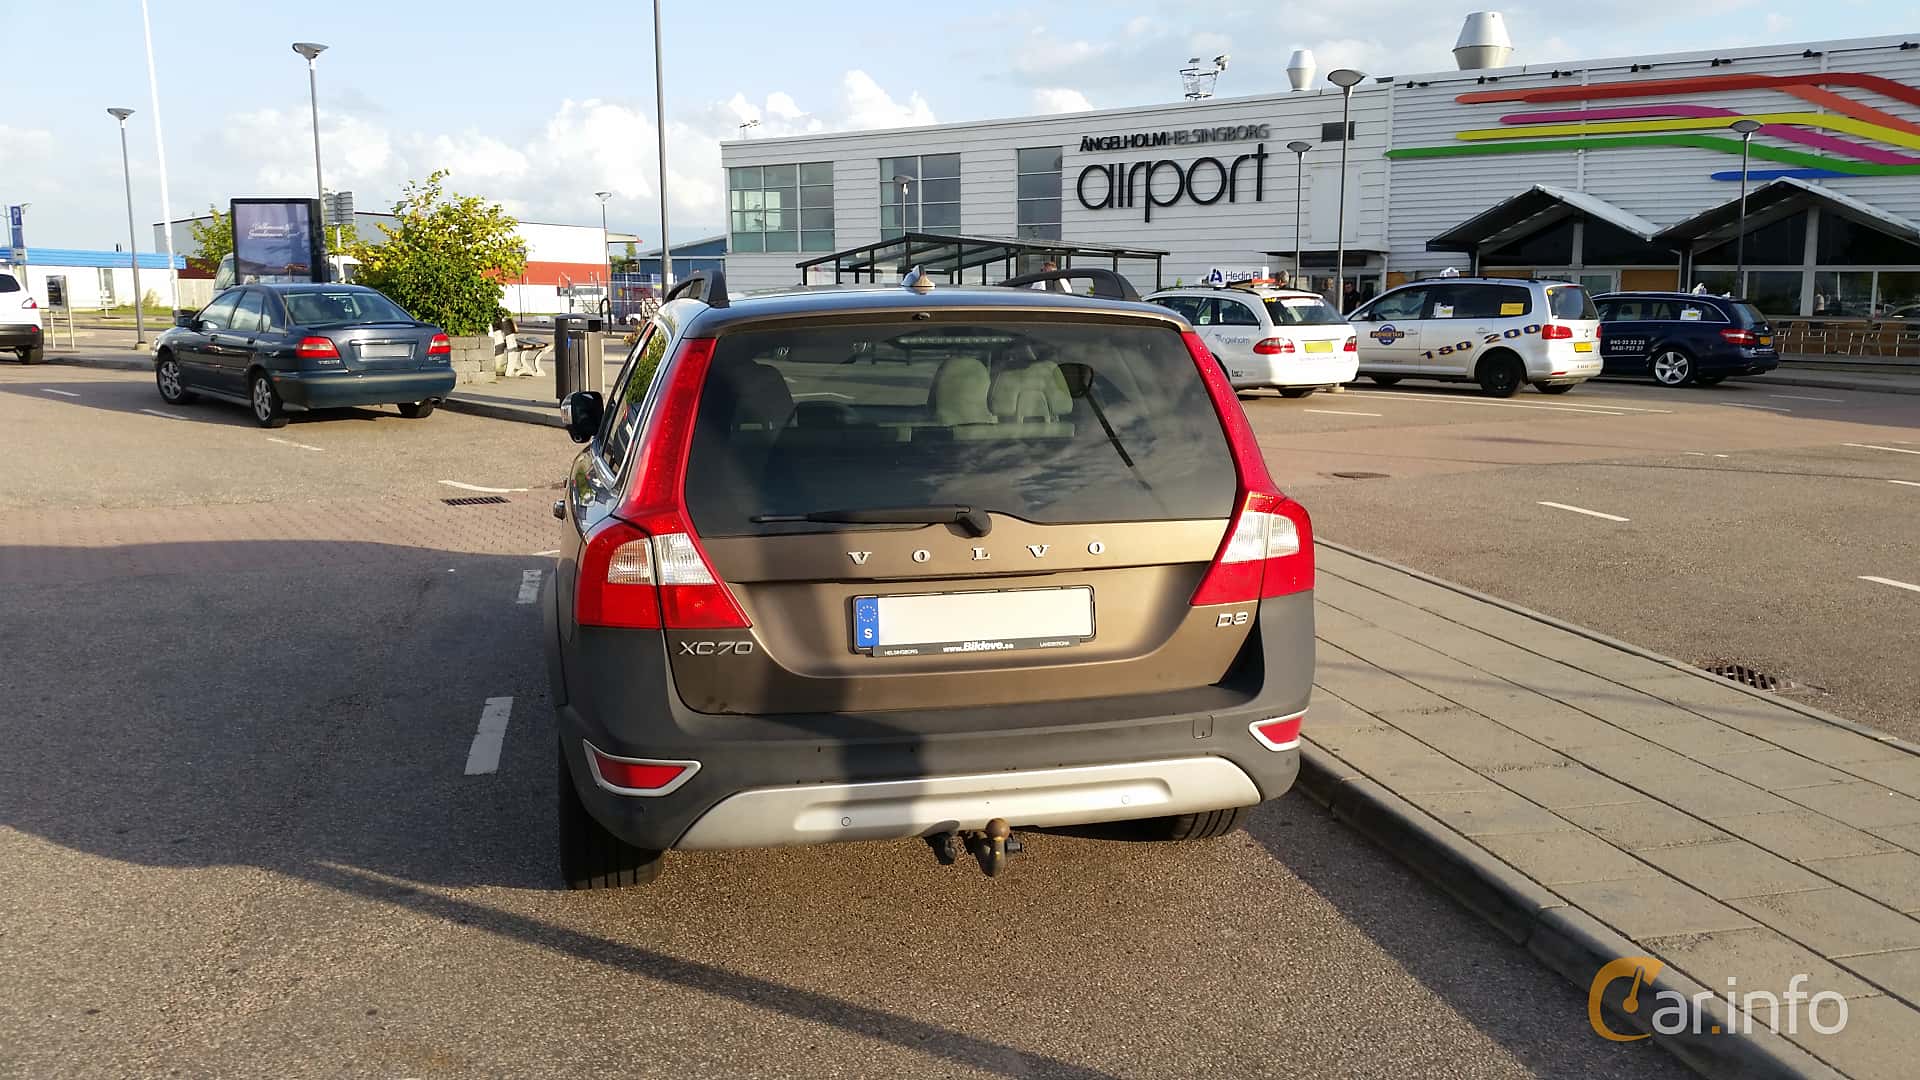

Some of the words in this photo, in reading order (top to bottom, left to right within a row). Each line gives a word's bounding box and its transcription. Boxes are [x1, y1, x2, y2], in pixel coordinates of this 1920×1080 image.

[1077, 143, 1269, 223] airport
[1483, 324, 1541, 345] 200
[848, 541, 1106, 565] VOLVO
[1216, 611, 1248, 627] D3
[863, 628, 873, 639] S
[679, 641, 753, 655] XC70
